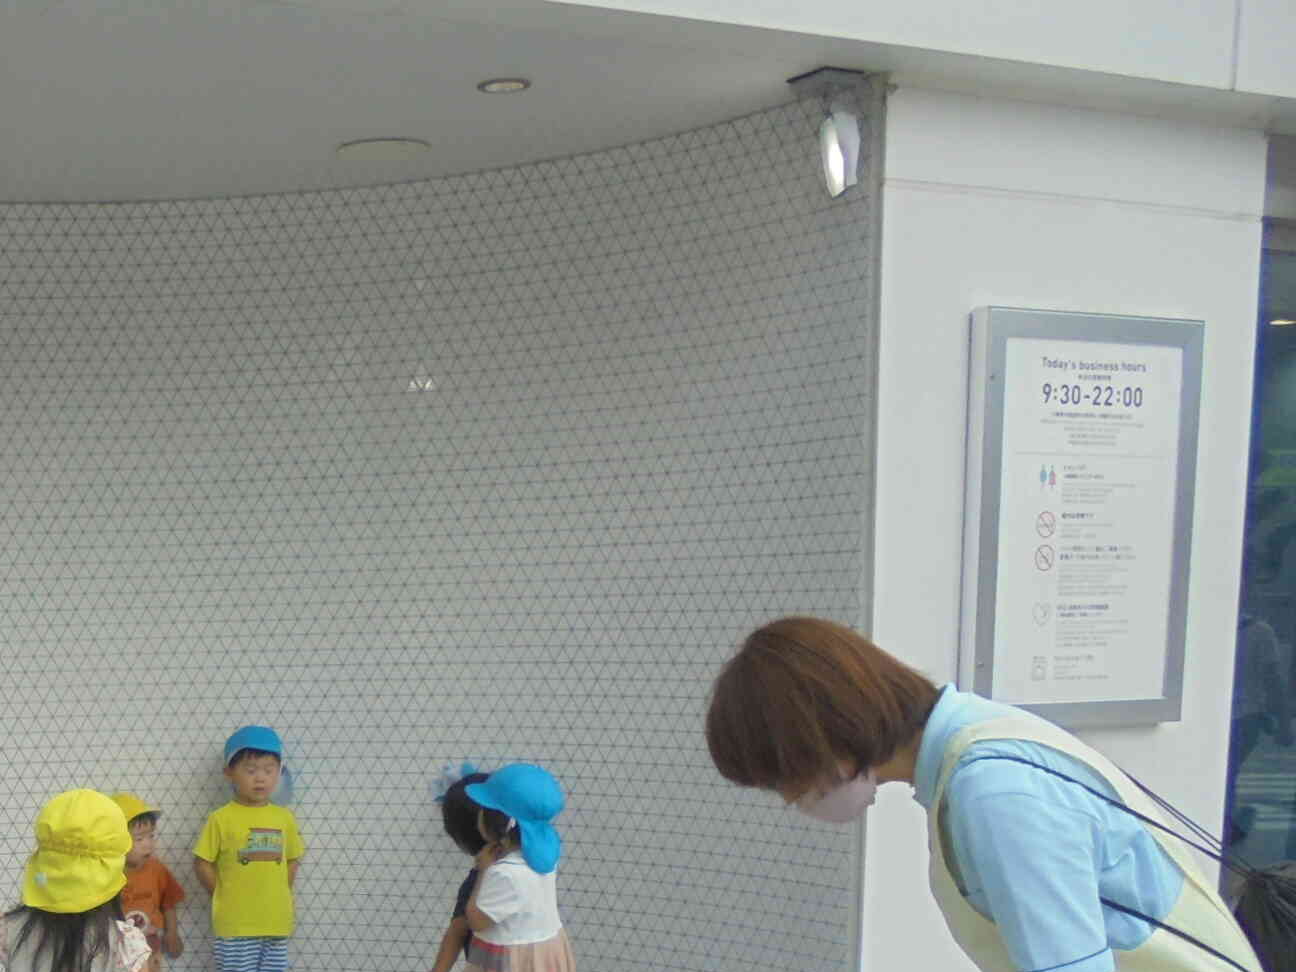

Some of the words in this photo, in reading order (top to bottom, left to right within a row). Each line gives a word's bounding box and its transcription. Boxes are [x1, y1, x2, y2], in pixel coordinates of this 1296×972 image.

[1041, 356, 1077, 372] Today's
[1079, 360, 1119, 372] business
[1121, 362, 1147, 373] hours
[1042, 383, 1144, 408] 9:30-22:00
